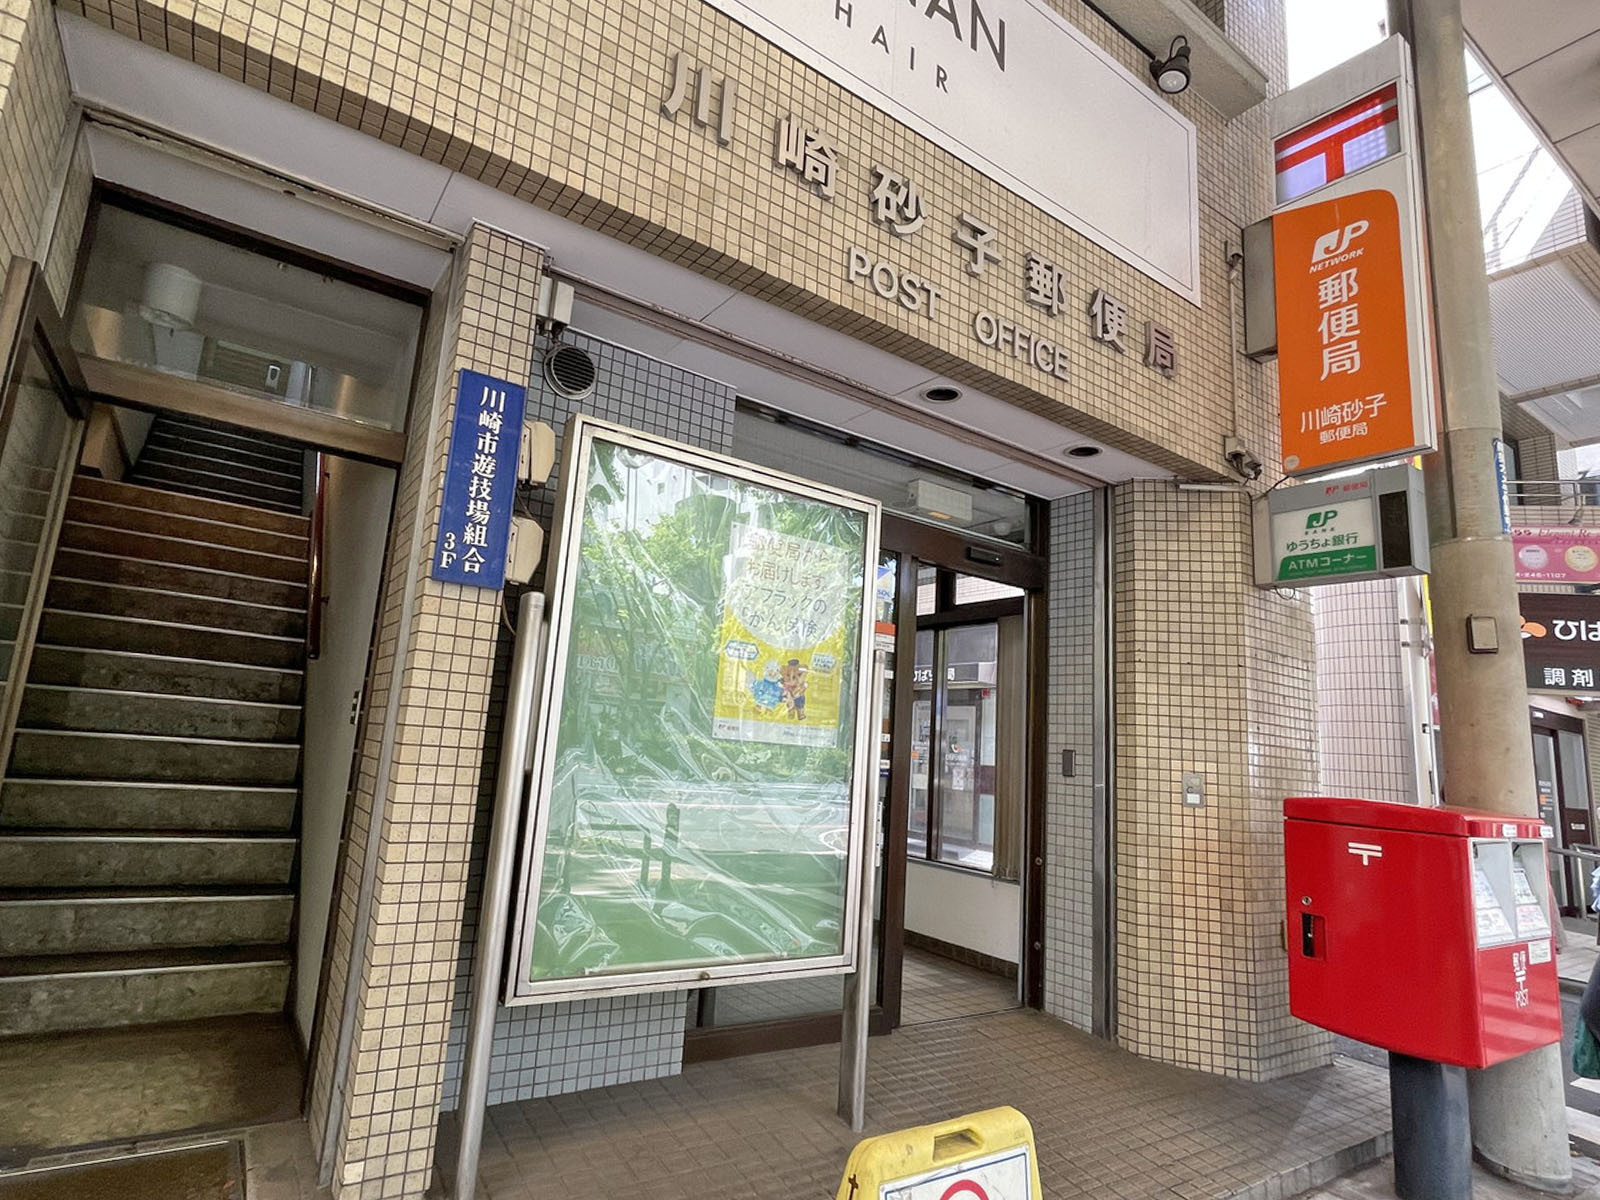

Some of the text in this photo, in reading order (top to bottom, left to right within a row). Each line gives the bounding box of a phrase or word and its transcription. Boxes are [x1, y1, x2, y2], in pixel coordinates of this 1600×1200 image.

[835, 0, 948, 93] HAIR
[908, 0, 1005, 72] AN
[661, 51, 1177, 377] 川崎砂子郵便局
[1309, 248, 1364, 274] NETWORK
[1311, 220, 1369, 263] JP
[848, 247, 1070, 382] POST OFFICE
[1318, 267, 1360, 381] 郵便局
[1301, 393, 1386, 433] 川崎砂子
[1320, 422, 1368, 444] 郵便局
[462, 386, 506, 573] 川崎市遊技場組合
[1306, 510, 1337, 529] JP
[440, 532, 456, 569] 3F
[1286, 532, 1358, 552] ゆうちょ銀行
[1288, 553, 1368, 571] ATMコーナー
[1543, 667, 1593, 687] 調剤
